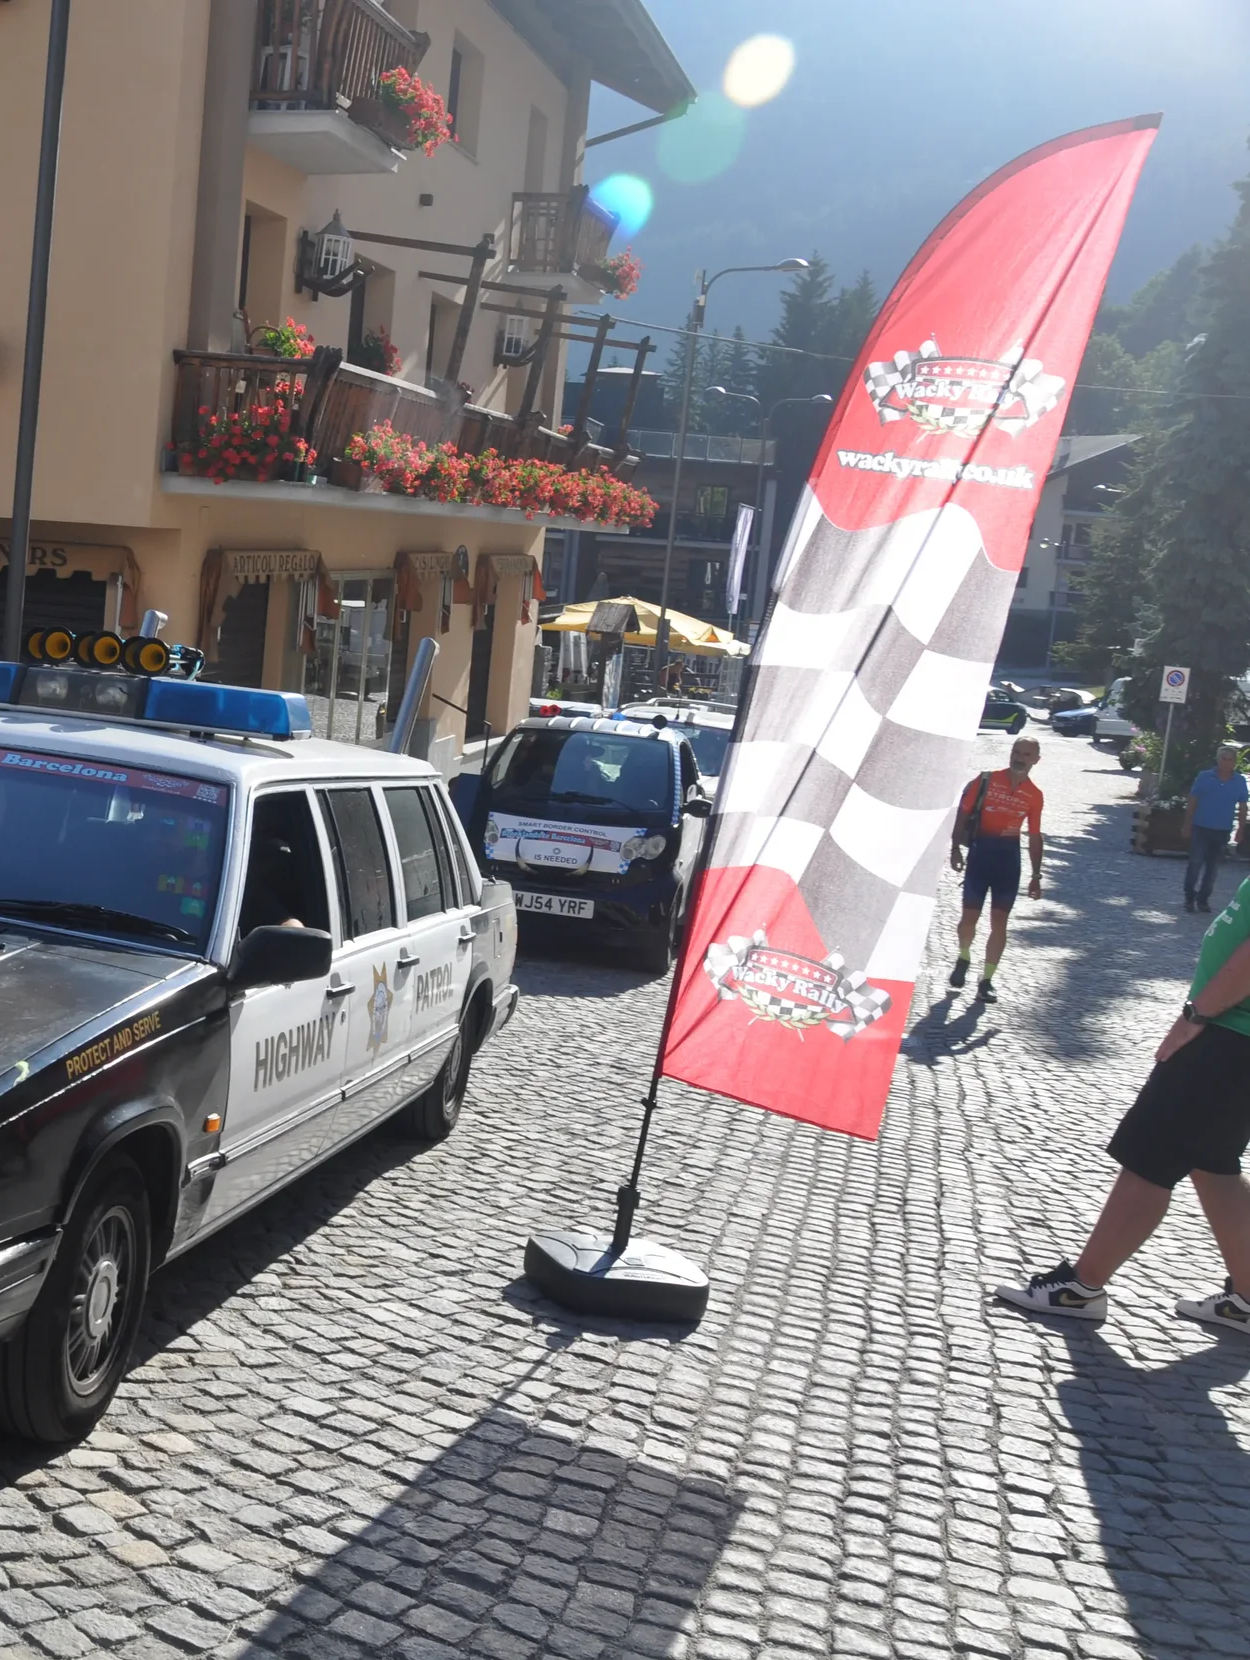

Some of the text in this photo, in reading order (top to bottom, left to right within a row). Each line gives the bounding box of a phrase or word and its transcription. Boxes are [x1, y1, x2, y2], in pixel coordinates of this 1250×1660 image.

[895, 381, 970, 402] Wacky
[233, 554, 316, 574] ARTICOLI REGALO
[1, 753, 128, 782] Barcelona
[518, 821, 608, 838] SMART BORDER CONTROL
[551, 832, 585, 844] Barcelona
[544, 855, 578, 865] NEEDED
[515, 893, 588, 915] WJ54 YRF
[731, 966, 849, 1014] Wacky Rally
[254, 961, 454, 1092] HIGHWAY PATROL
[65, 1010, 162, 1080] PROTECT AND SERVE
